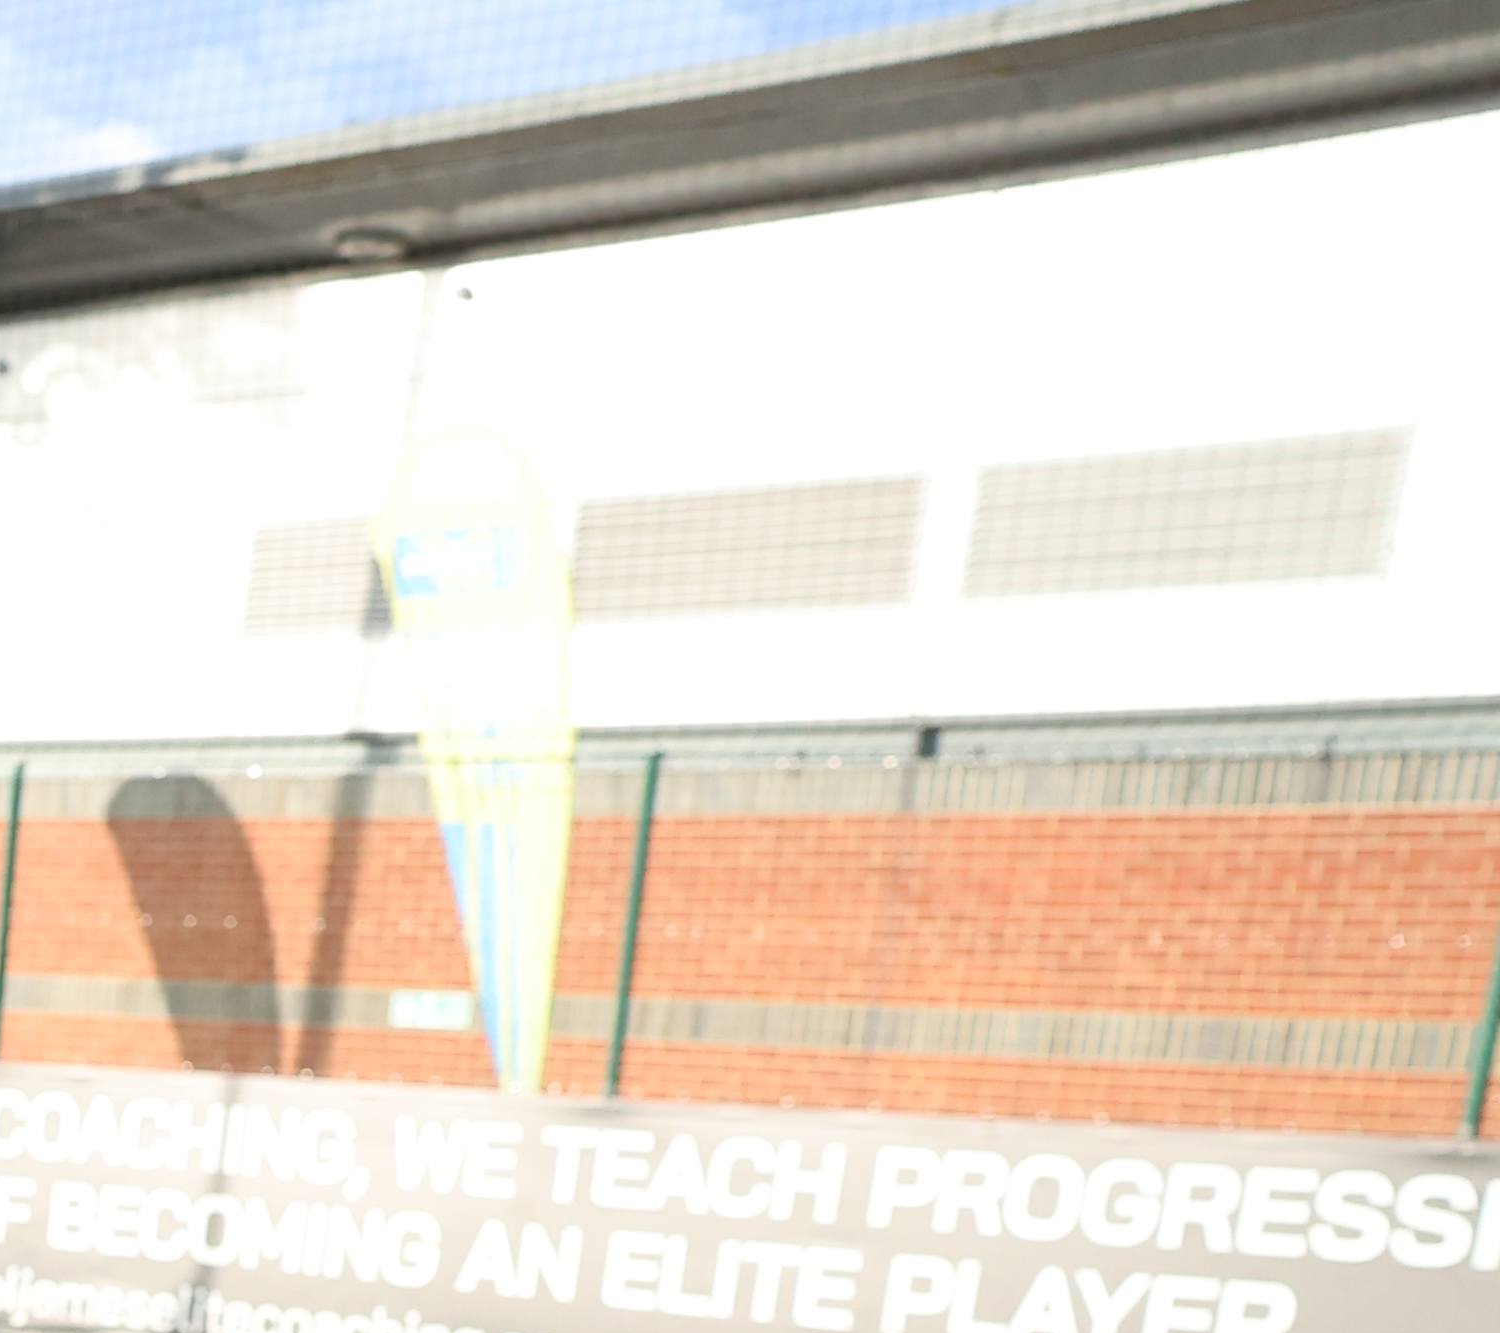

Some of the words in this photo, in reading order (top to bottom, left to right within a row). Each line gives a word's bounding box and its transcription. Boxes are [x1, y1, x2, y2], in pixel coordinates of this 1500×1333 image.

[394, 1112, 523, 1198] WE
[541, 1122, 847, 1225] TEACH
[47, 1178, 443, 1287] BECOMING
[454, 1217, 584, 1303] AN
[601, 1228, 865, 1333] ELITE
